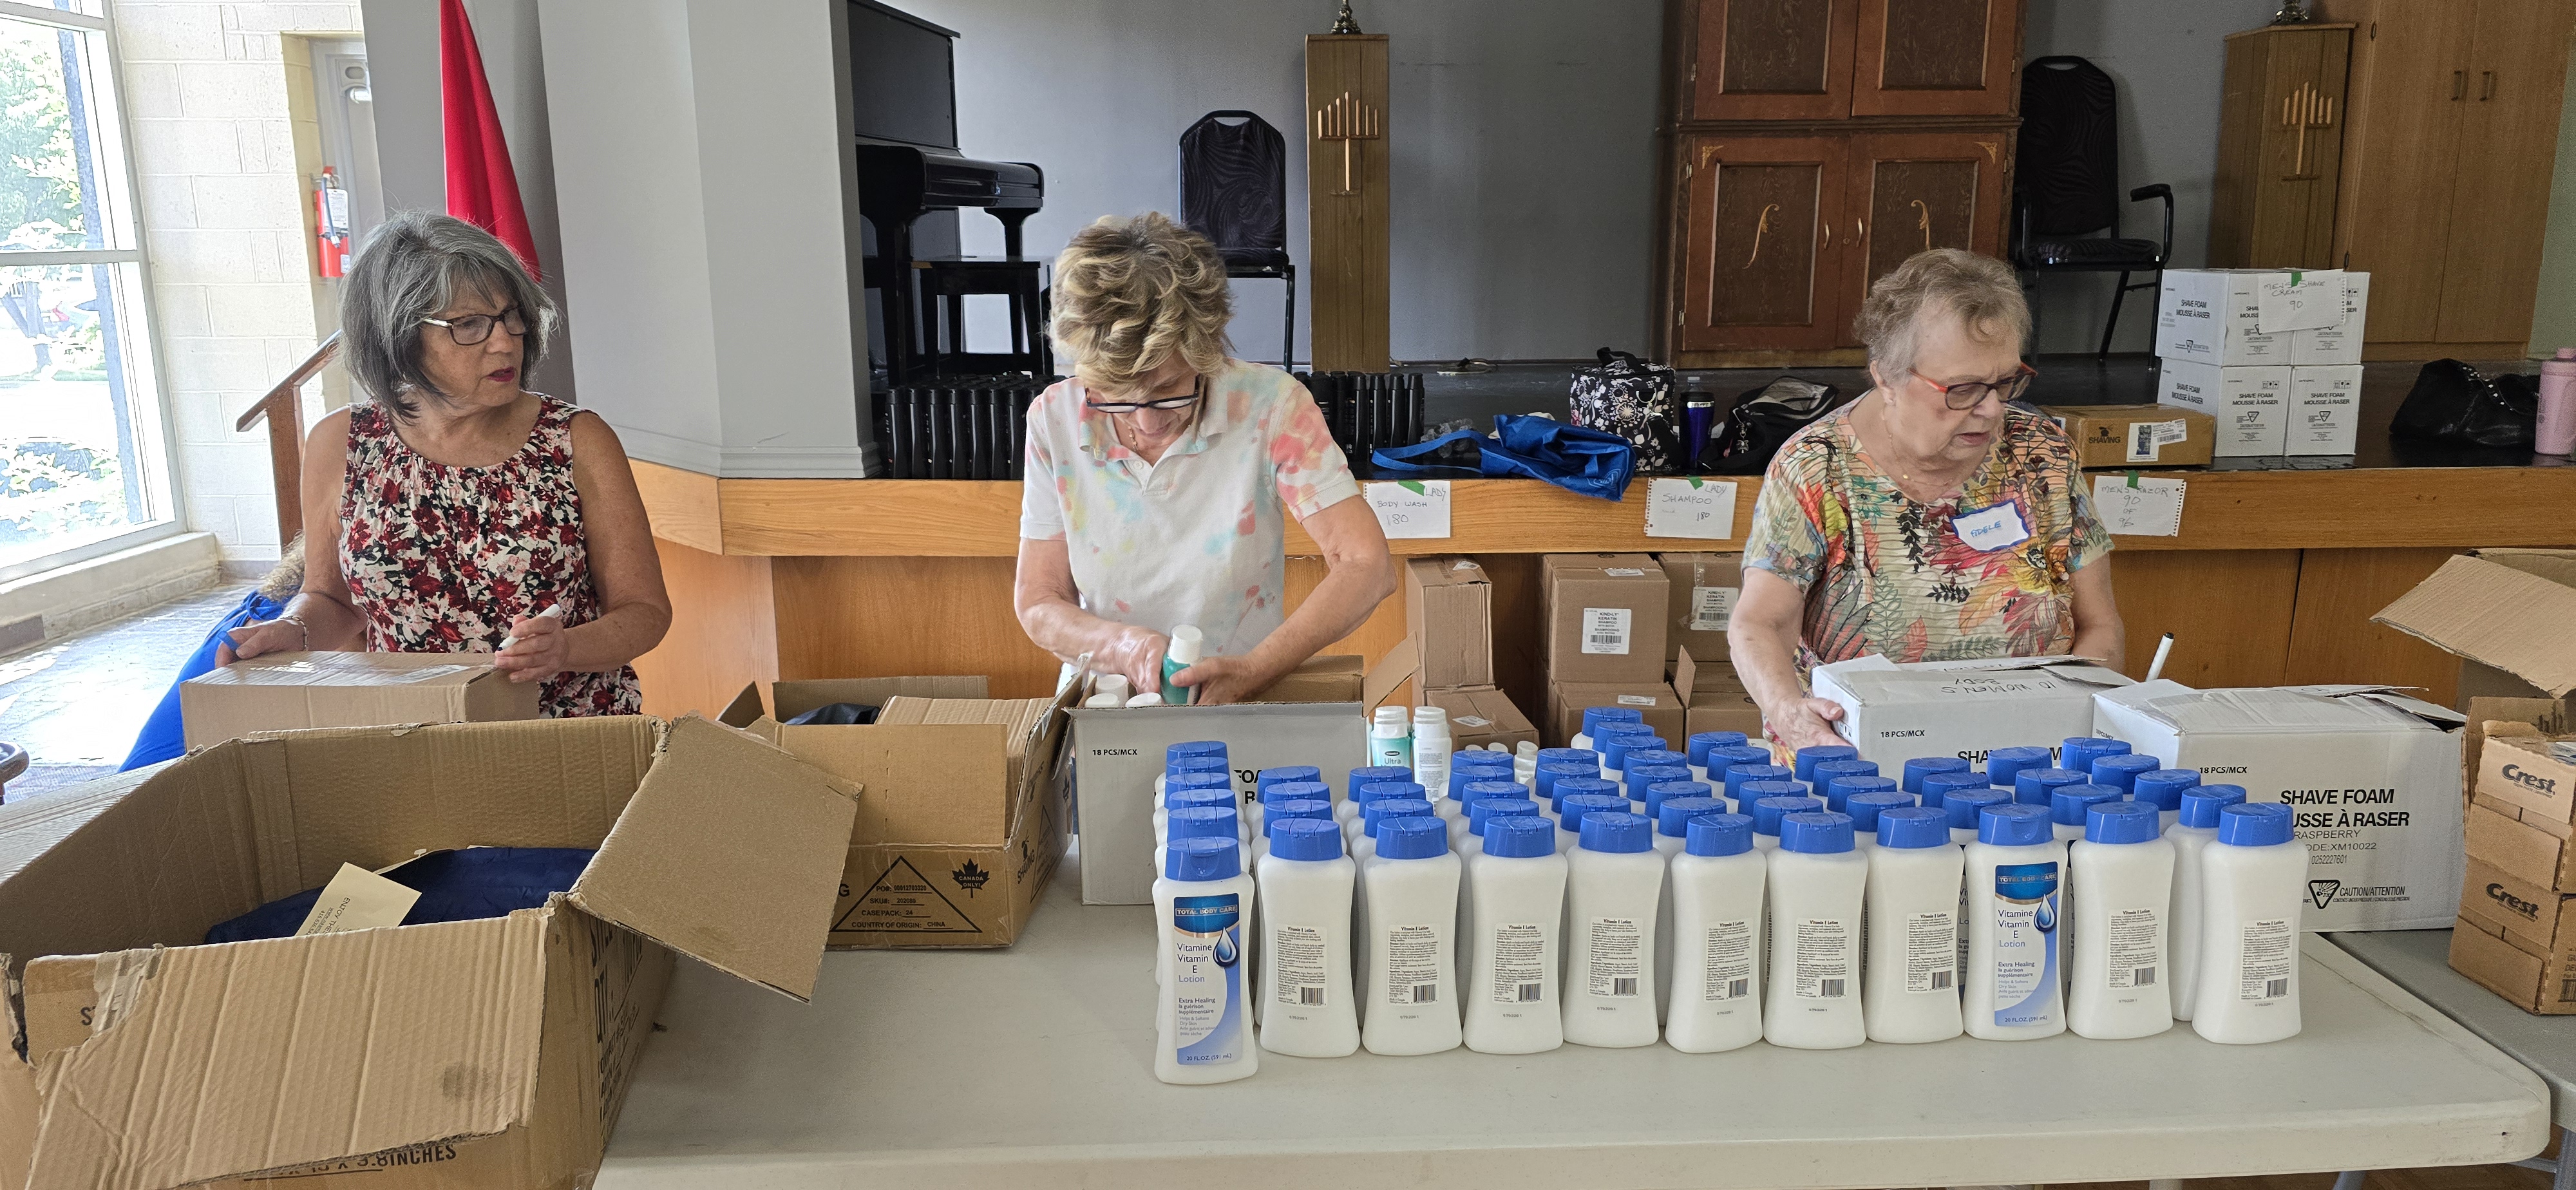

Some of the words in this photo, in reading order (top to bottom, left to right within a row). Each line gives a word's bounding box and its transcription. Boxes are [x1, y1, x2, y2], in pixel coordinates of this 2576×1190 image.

[2289, 300, 2304, 310] 90
[2177, 382, 2189, 391] SHAVE
[2188, 384, 2201, 393] FOAM
[1426, 487, 1446, 502] LADY
[1705, 484, 1727, 498] LADY
[1662, 493, 1712, 504] SHAMPOO
[2123, 495, 2141, 507] 90
[1387, 513, 1409, 526] 180
[1696, 511, 1710, 522] 180
[2118, 516, 2134, 528] 96
[2502, 764, 2556, 795] Crest
[2280, 789, 2338, 805] SHAVE
[2343, 788, 2394, 804] FOAM
[2336, 809, 2350, 827] À
[2353, 811, 2410, 827] RASER
[2306, 842, 2377, 852] ODE:XM10022
[2340, 886, 2405, 896] CAUTION/ATTENTION
[2486, 883, 2539, 920] Crest
[334, 897, 351, 919] ENJOY
[1998, 909, 2033, 918] Vitamine
[1177, 943, 1212, 952] Vitamine
[1177, 954, 1209, 963] Vitamin
[1179, 974, 1205, 983] Lotion
